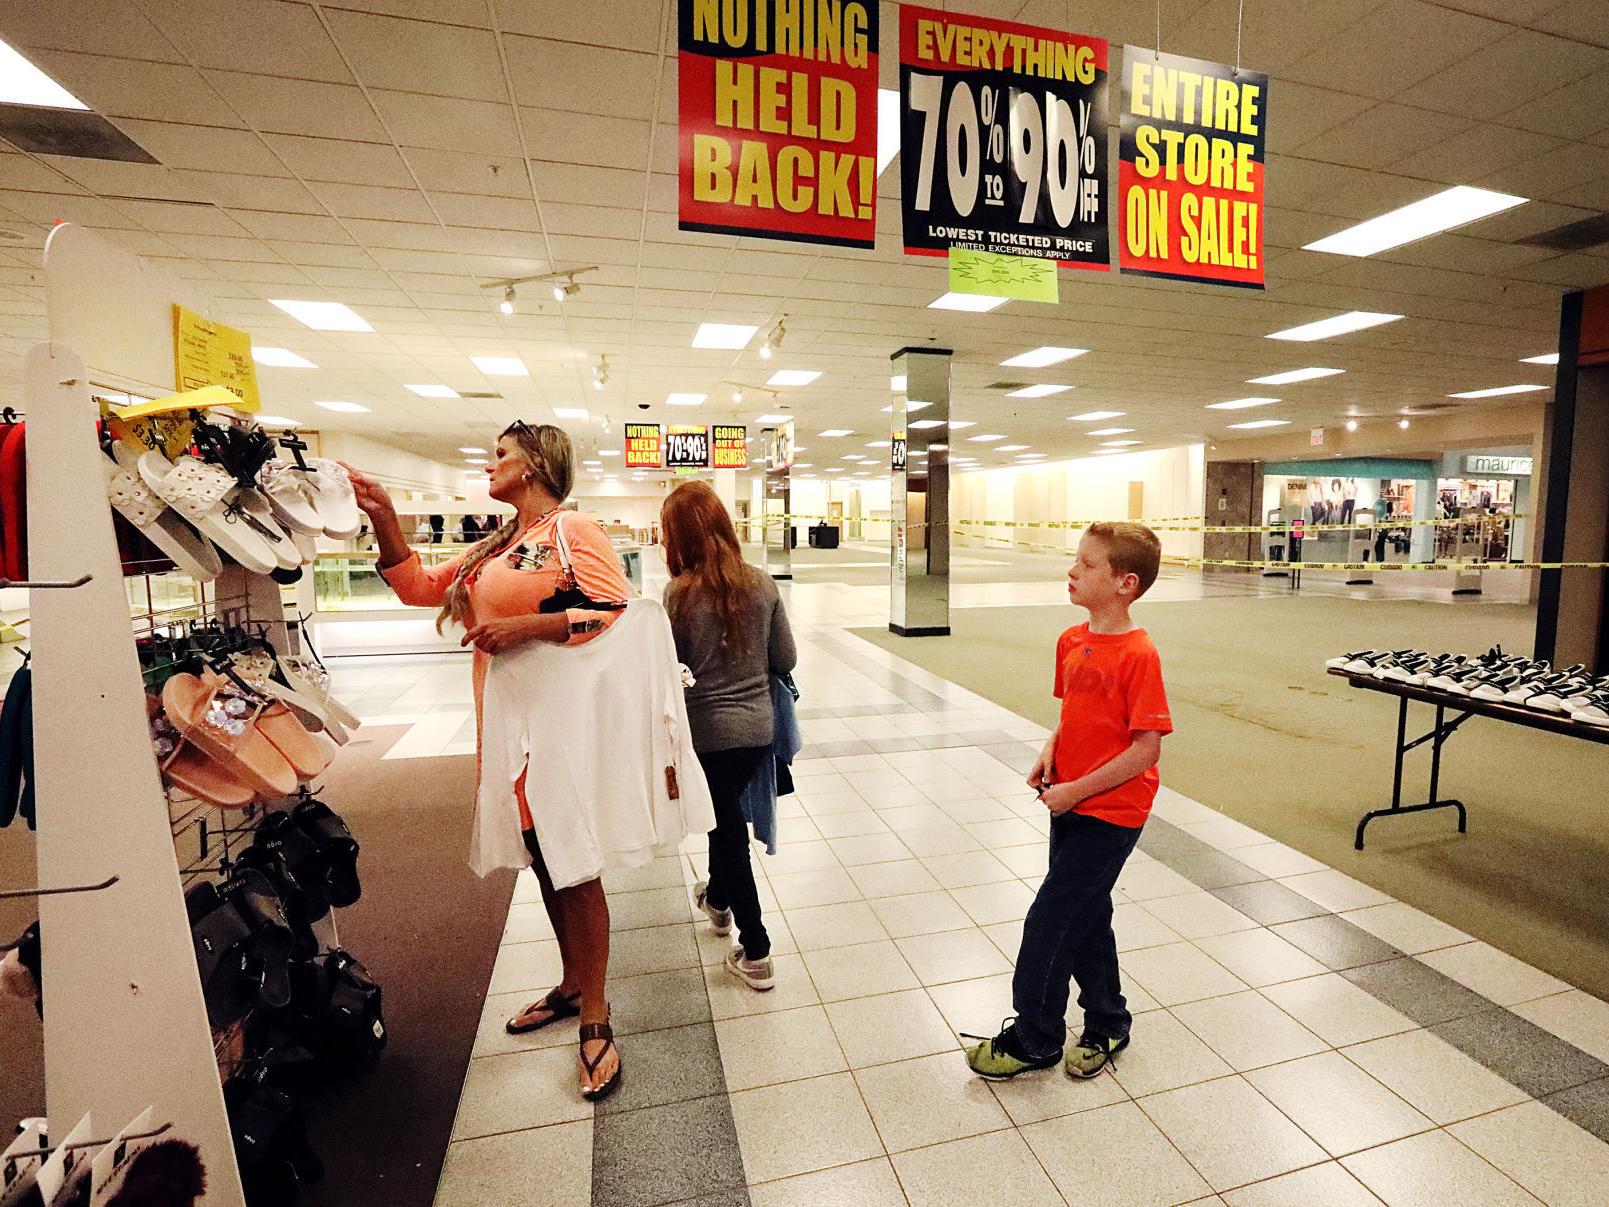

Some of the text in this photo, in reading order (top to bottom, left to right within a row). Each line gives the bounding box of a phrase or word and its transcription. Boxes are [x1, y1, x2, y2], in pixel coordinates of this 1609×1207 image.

[917, 18, 1096, 85] EVERYTHING
[715, 59, 857, 143] HELD
[1130, 61, 1260, 137] ENTIRE
[910, 71, 1004, 217] 70%
[984, 174, 1004, 200] TO
[1135, 125, 1255, 193] STORE
[693, 133, 875, 220] BACK!
[928, 225, 1093, 252] LOWEST TICKETED PRICE
[1126, 184, 1258, 270] ON SALE!
[950, 241, 1071, 260] LIMITED EXCEPTIONS APPLY
[626, 425, 659, 438] NOTHING
[631, 438, 657, 450] HELD
[715, 427, 744, 439] GOING
[715, 439, 744, 448] OUT OF
[627, 451, 661, 464] BACK!
[714, 448, 746, 466] BUSINESS
